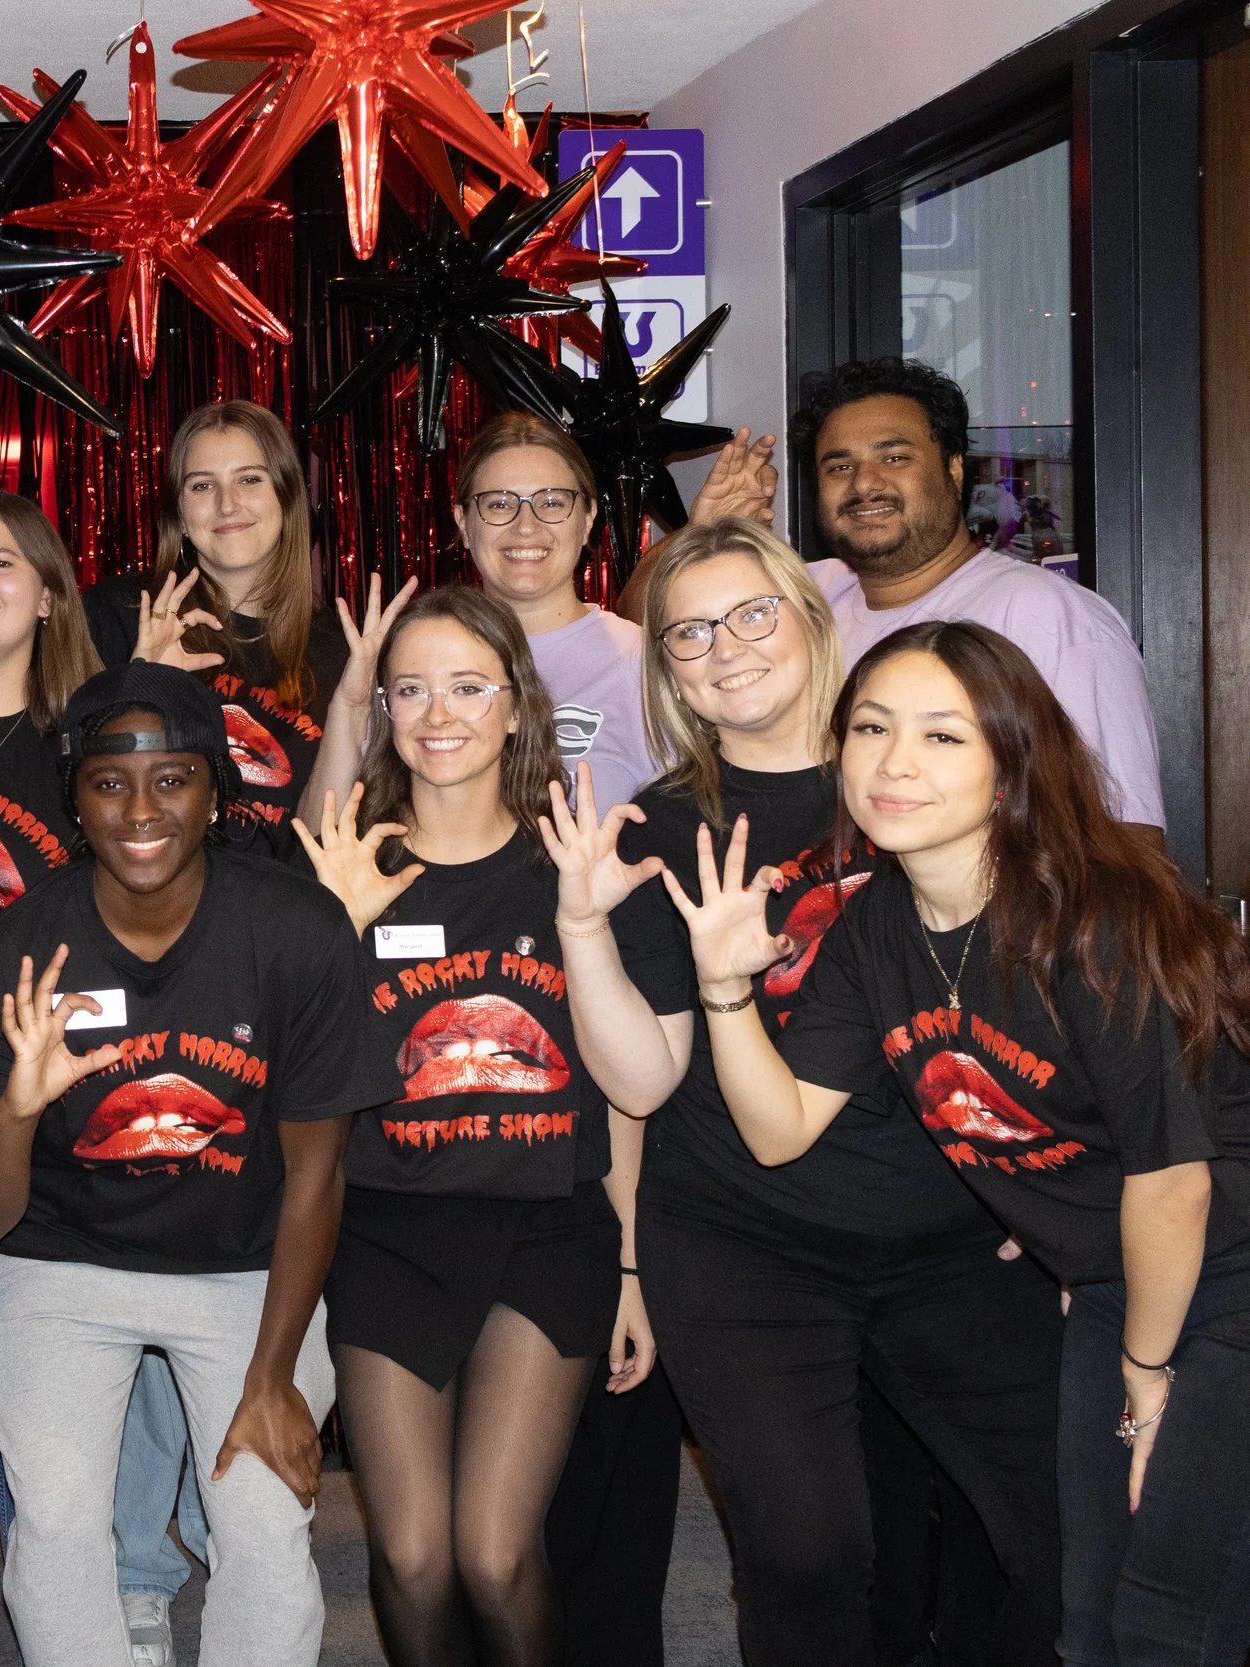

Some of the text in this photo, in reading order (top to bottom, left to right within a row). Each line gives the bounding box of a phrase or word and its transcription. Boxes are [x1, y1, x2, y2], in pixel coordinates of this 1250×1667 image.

[398, 950, 491, 999] ROCKY
[501, 952, 566, 1001] HORR
[180, 1032, 268, 1089] HORROR
[970, 1013, 1056, 1089] HORROR
[382, 1112, 573, 1152] PICTURE SHOW
